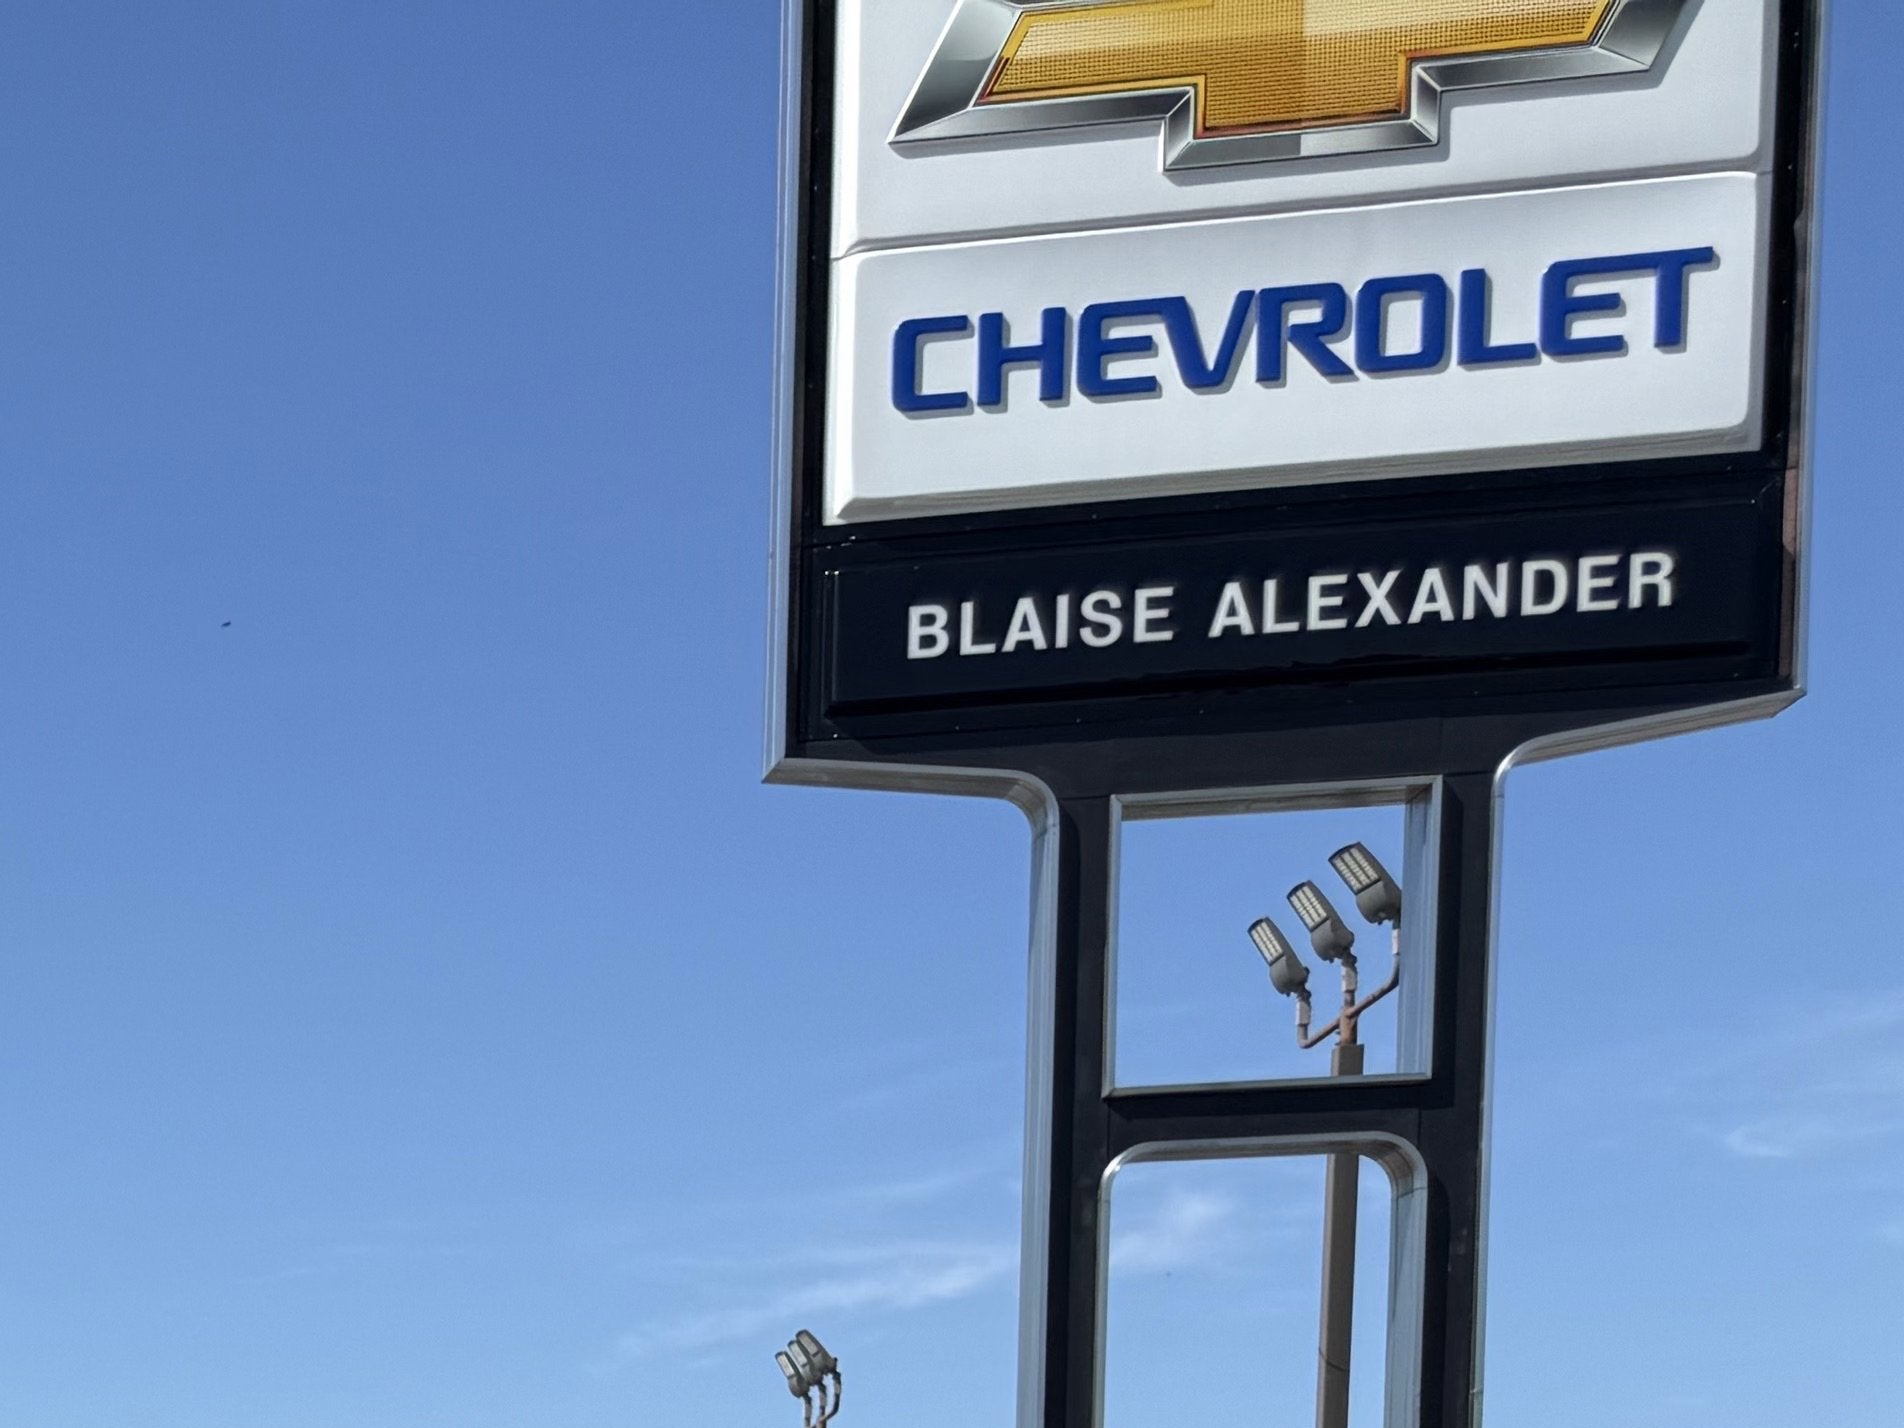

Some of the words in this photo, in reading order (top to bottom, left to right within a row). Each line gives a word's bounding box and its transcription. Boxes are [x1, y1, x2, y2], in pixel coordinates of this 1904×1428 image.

[891, 246, 1716, 414] CHEVROLET
[906, 586, 1176, 660] BLAISE
[1207, 552, 1676, 638] ALEXANDER
